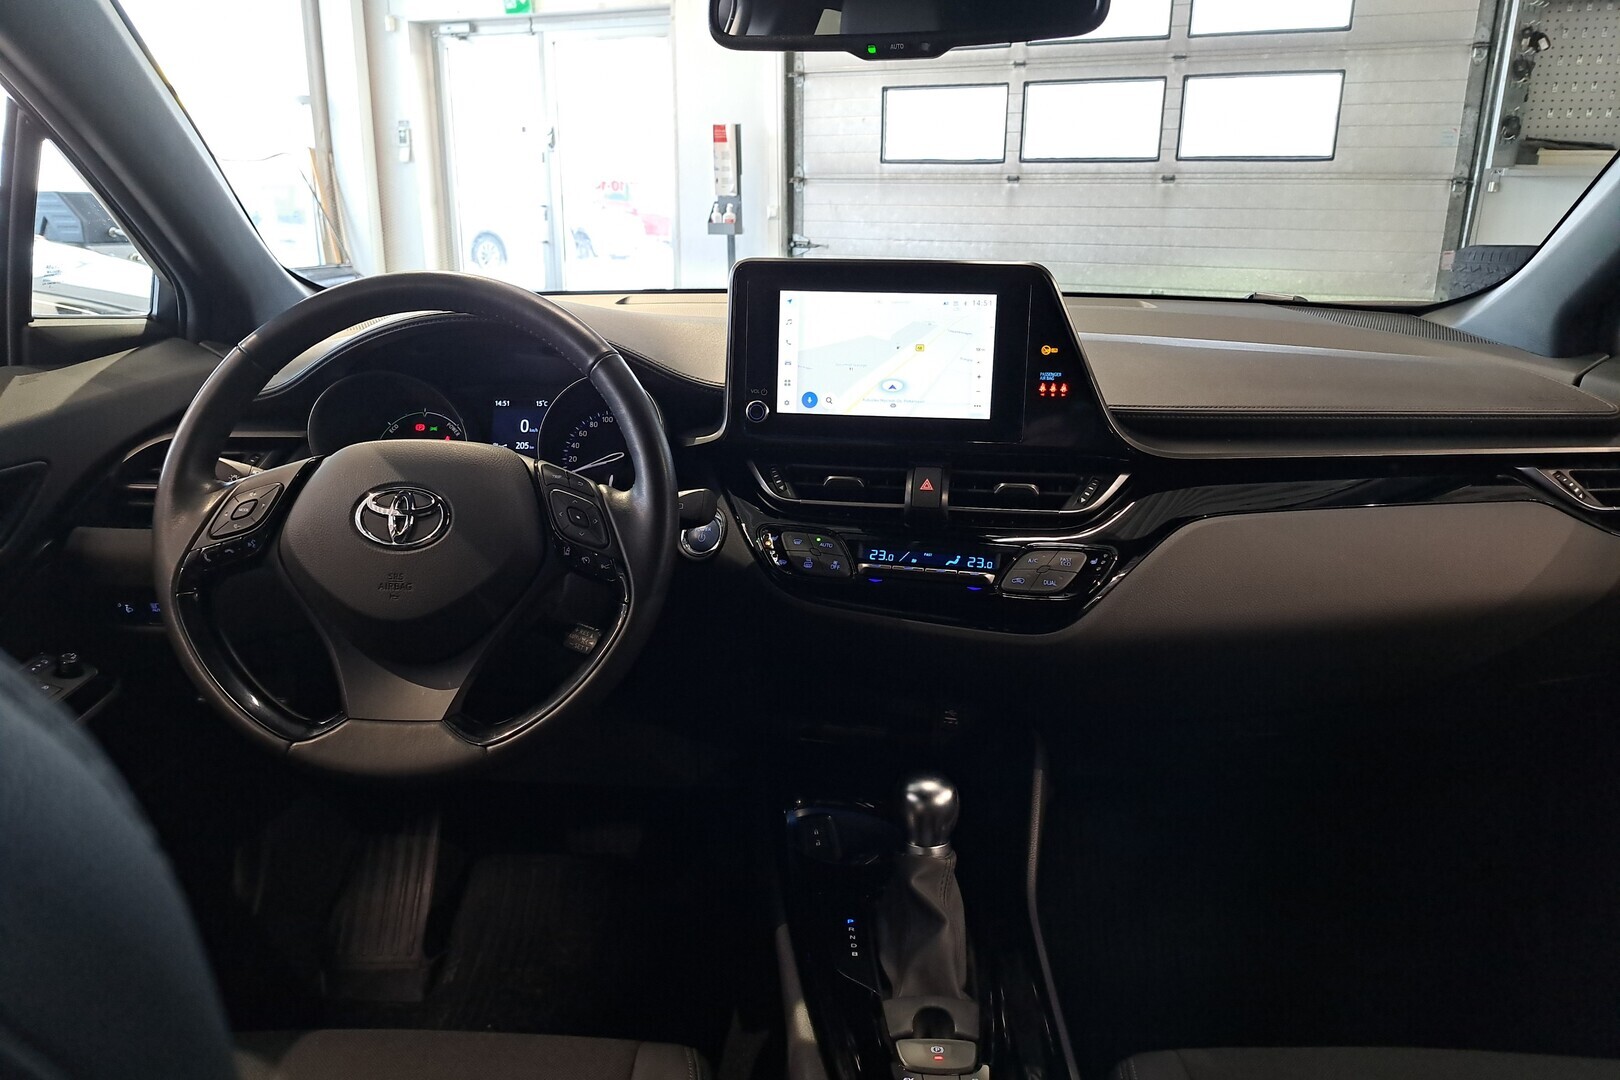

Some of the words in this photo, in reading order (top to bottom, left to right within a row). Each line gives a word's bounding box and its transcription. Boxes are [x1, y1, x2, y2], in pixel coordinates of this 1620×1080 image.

[590, 420, 598, 428] 80
[602, 416, 614, 424] 100
[389, 424, 399, 434] ECO
[446, 422, 460, 436] POWER
[520, 419, 530, 434] 0
[579, 430, 588, 438] 60
[516, 442, 530, 450] 205
[571, 442, 580, 450] 40
[568, 454, 578, 462] 20
[870, 549, 894, 562] 23.0
[966, 556, 993, 569] 23.0
[388, 572, 404, 580] SRS
[377, 582, 414, 591] AIRBAG
